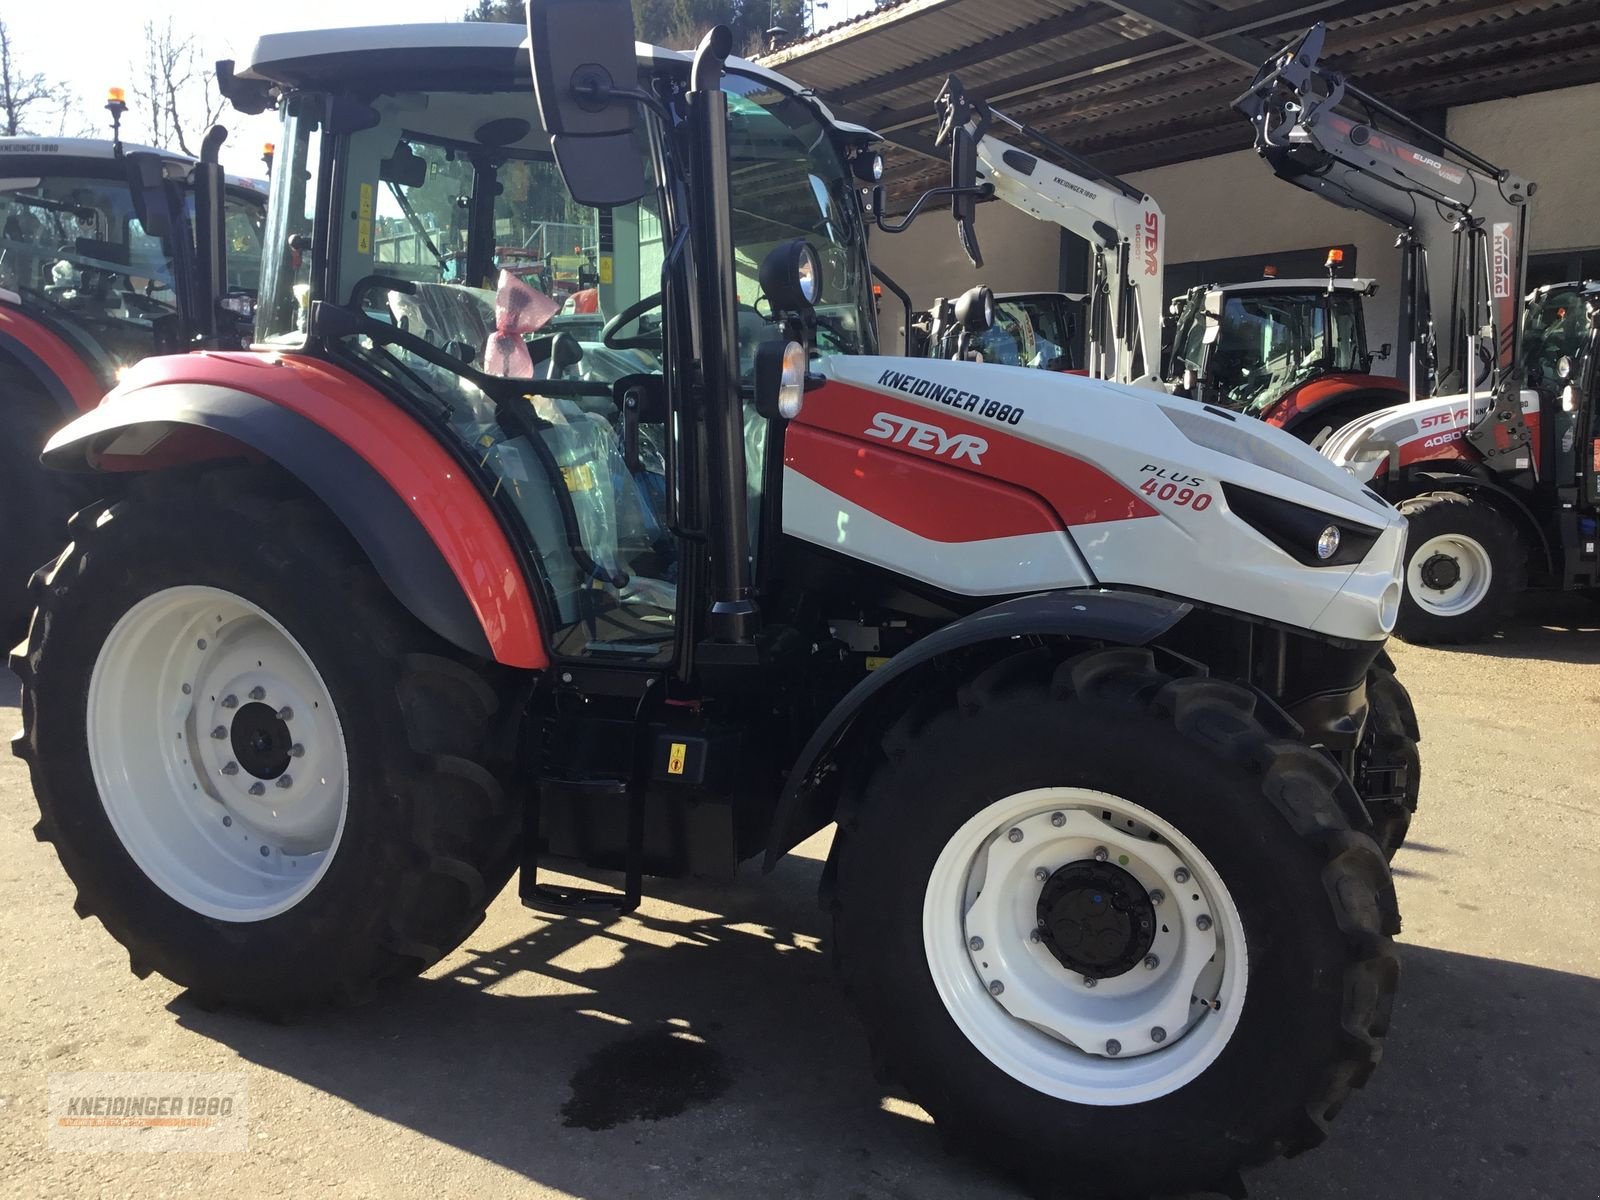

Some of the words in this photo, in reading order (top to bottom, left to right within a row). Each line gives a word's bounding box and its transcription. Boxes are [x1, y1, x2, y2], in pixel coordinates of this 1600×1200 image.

[1413, 153, 1442, 169] EURO
[1145, 210, 1158, 276] STEYR
[1494, 235, 1503, 294] HYDRAC
[877, 369, 980, 413] KNEIDINGER
[978, 398, 1025, 426] 1880
[1420, 408, 1469, 430] STEYR
[863, 411, 989, 466] STEYR
[1424, 431, 1462, 448] 4080
[1139, 464, 1205, 487] PLUS
[1139, 477, 1213, 512] 4090
